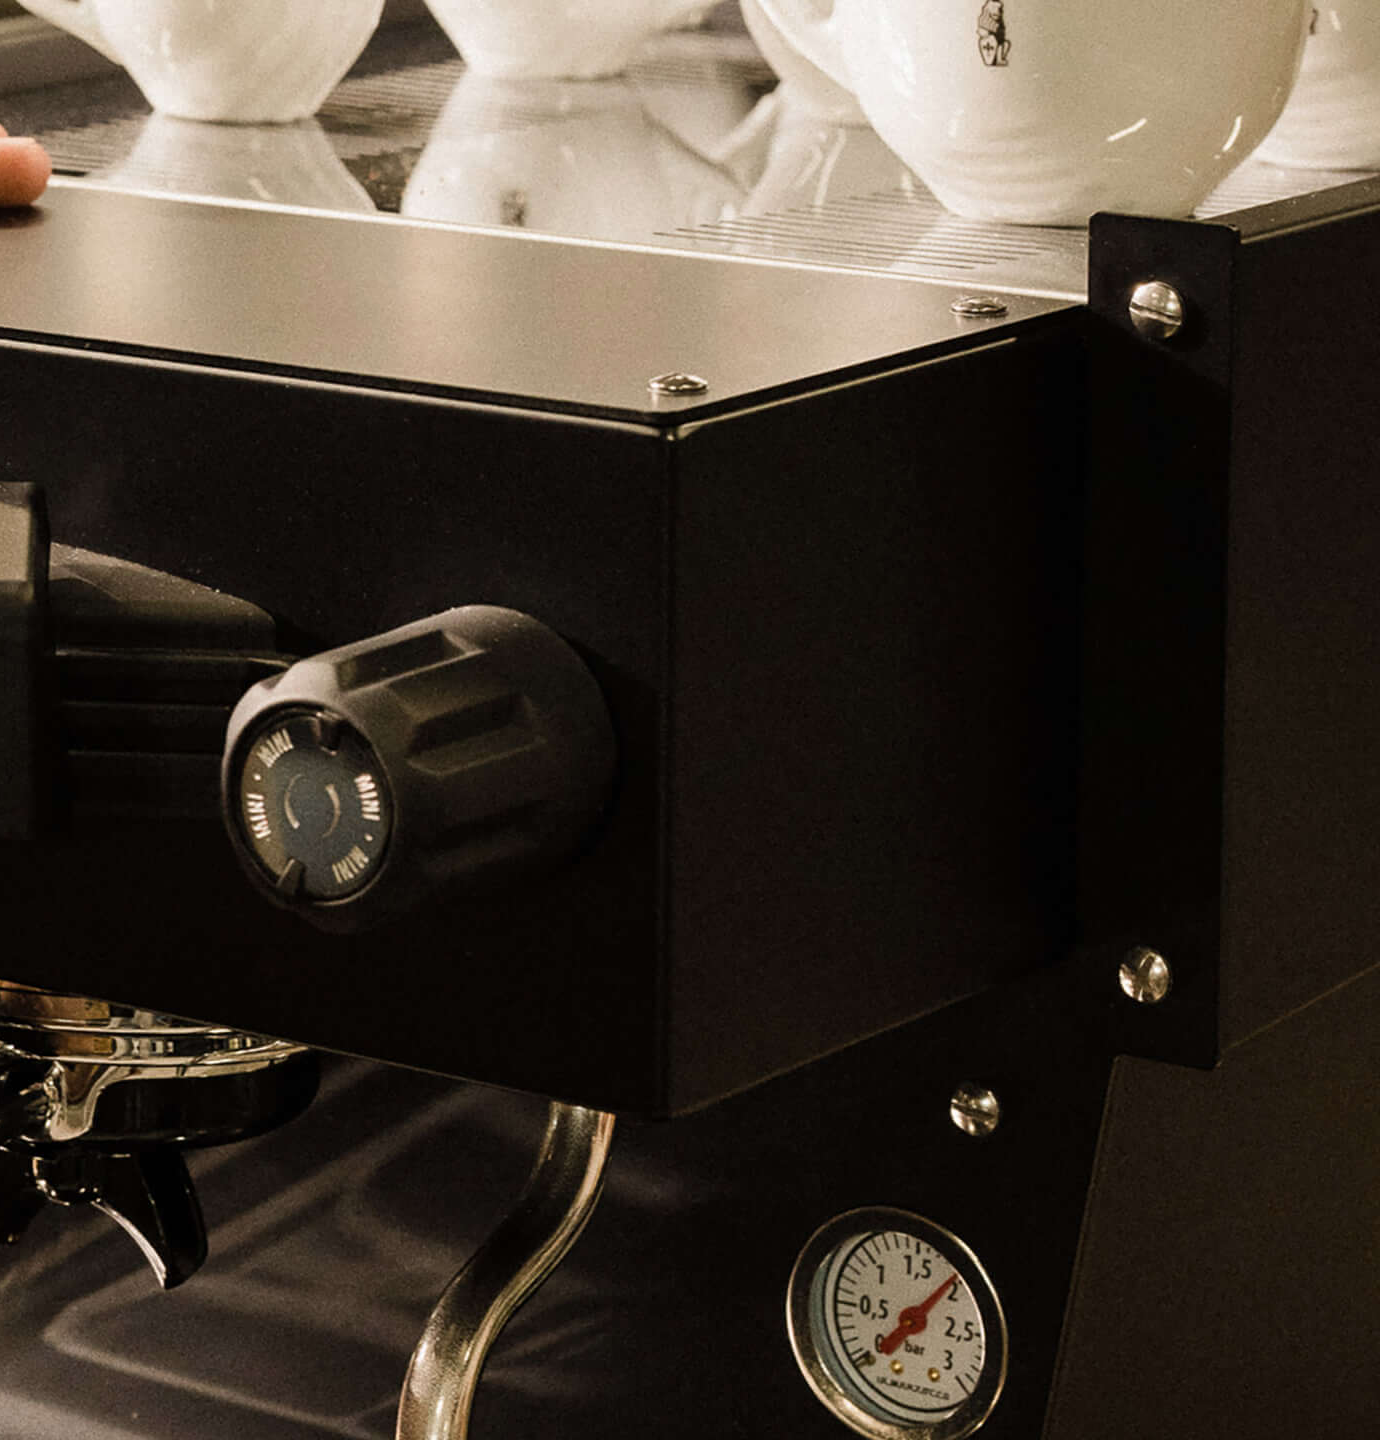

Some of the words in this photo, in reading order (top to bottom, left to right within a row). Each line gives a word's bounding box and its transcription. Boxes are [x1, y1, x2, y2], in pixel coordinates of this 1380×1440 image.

[876, 1265, 885, 1285] 1
[904, 1254, 932, 1280] 1,5
[860, 1294, 889, 1320] 0,5
[945, 1316, 974, 1342] 2,5
[905, 1341, 925, 1355] bar
[943, 1350, 953, 1370] 3
